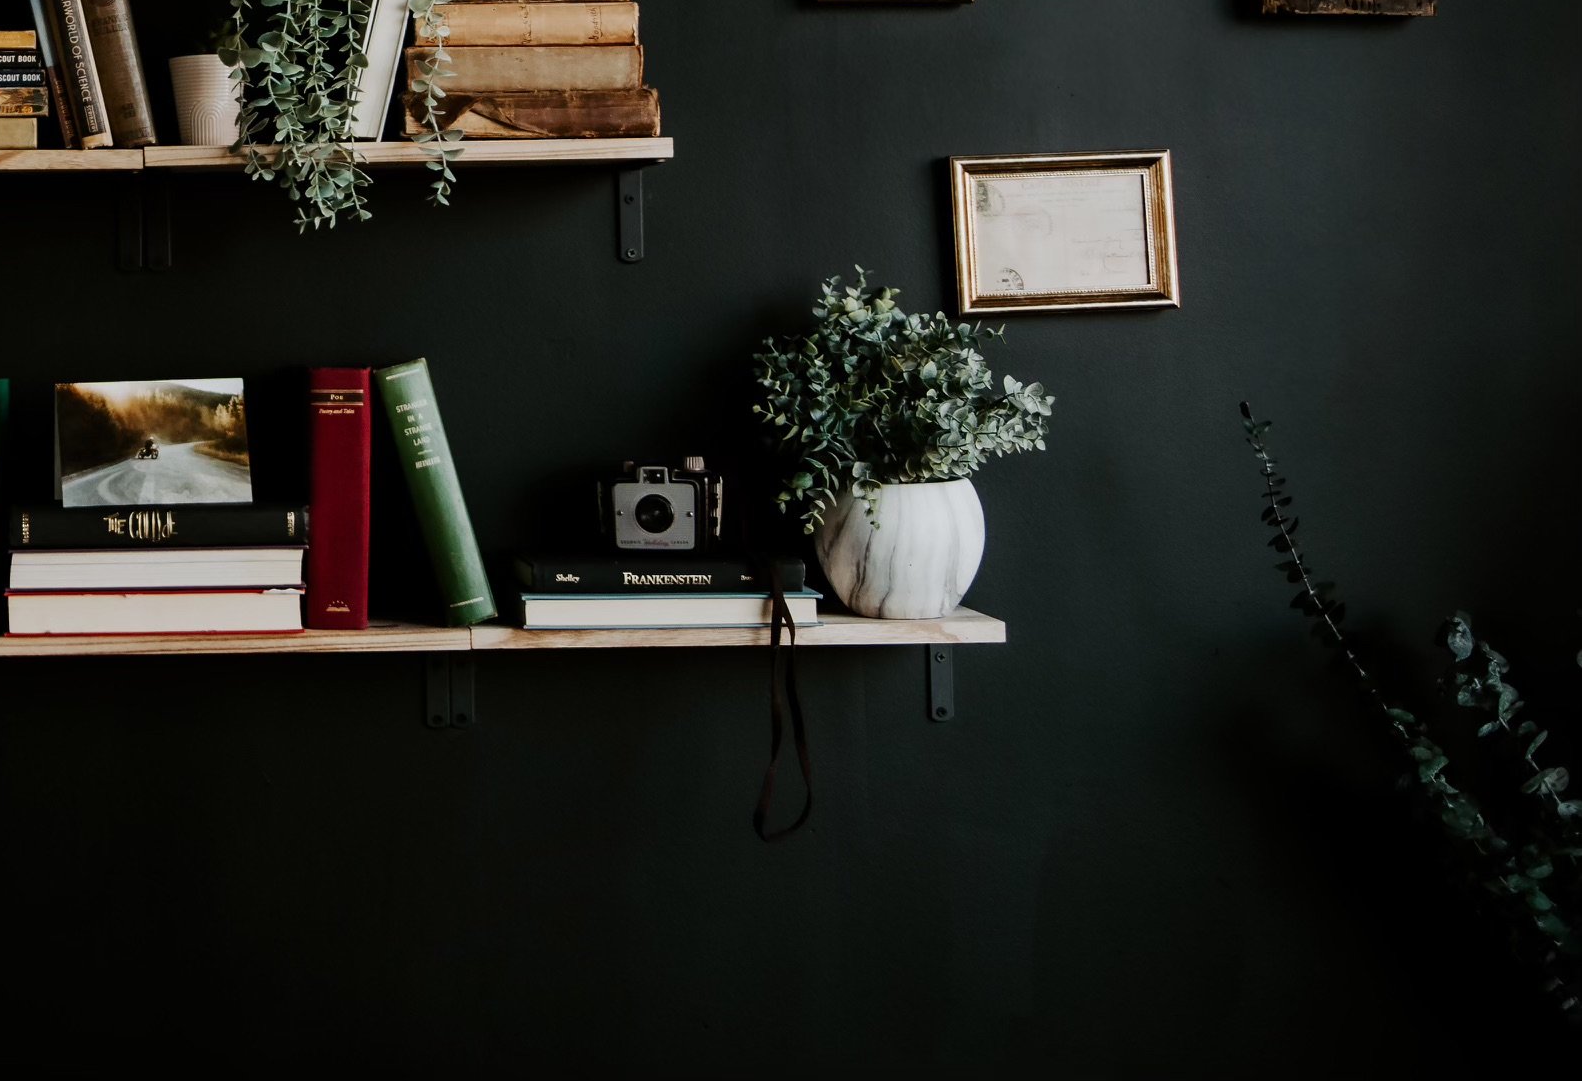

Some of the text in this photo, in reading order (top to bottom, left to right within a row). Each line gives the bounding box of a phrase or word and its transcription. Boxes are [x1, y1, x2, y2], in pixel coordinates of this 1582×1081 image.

[72, 45, 82, 60] OF
[18, 55, 37, 63] BOOK
[22, 74, 41, 82] BOOK
[75, 61, 92, 102] SCIENCE
[407, 414, 416, 423] IN
[404, 422, 432, 436] STRANGE
[413, 436, 431, 446] LAND
[556, 573, 580, 583] Shelley
[623, 572, 712, 585] FRANKENSTEIN
